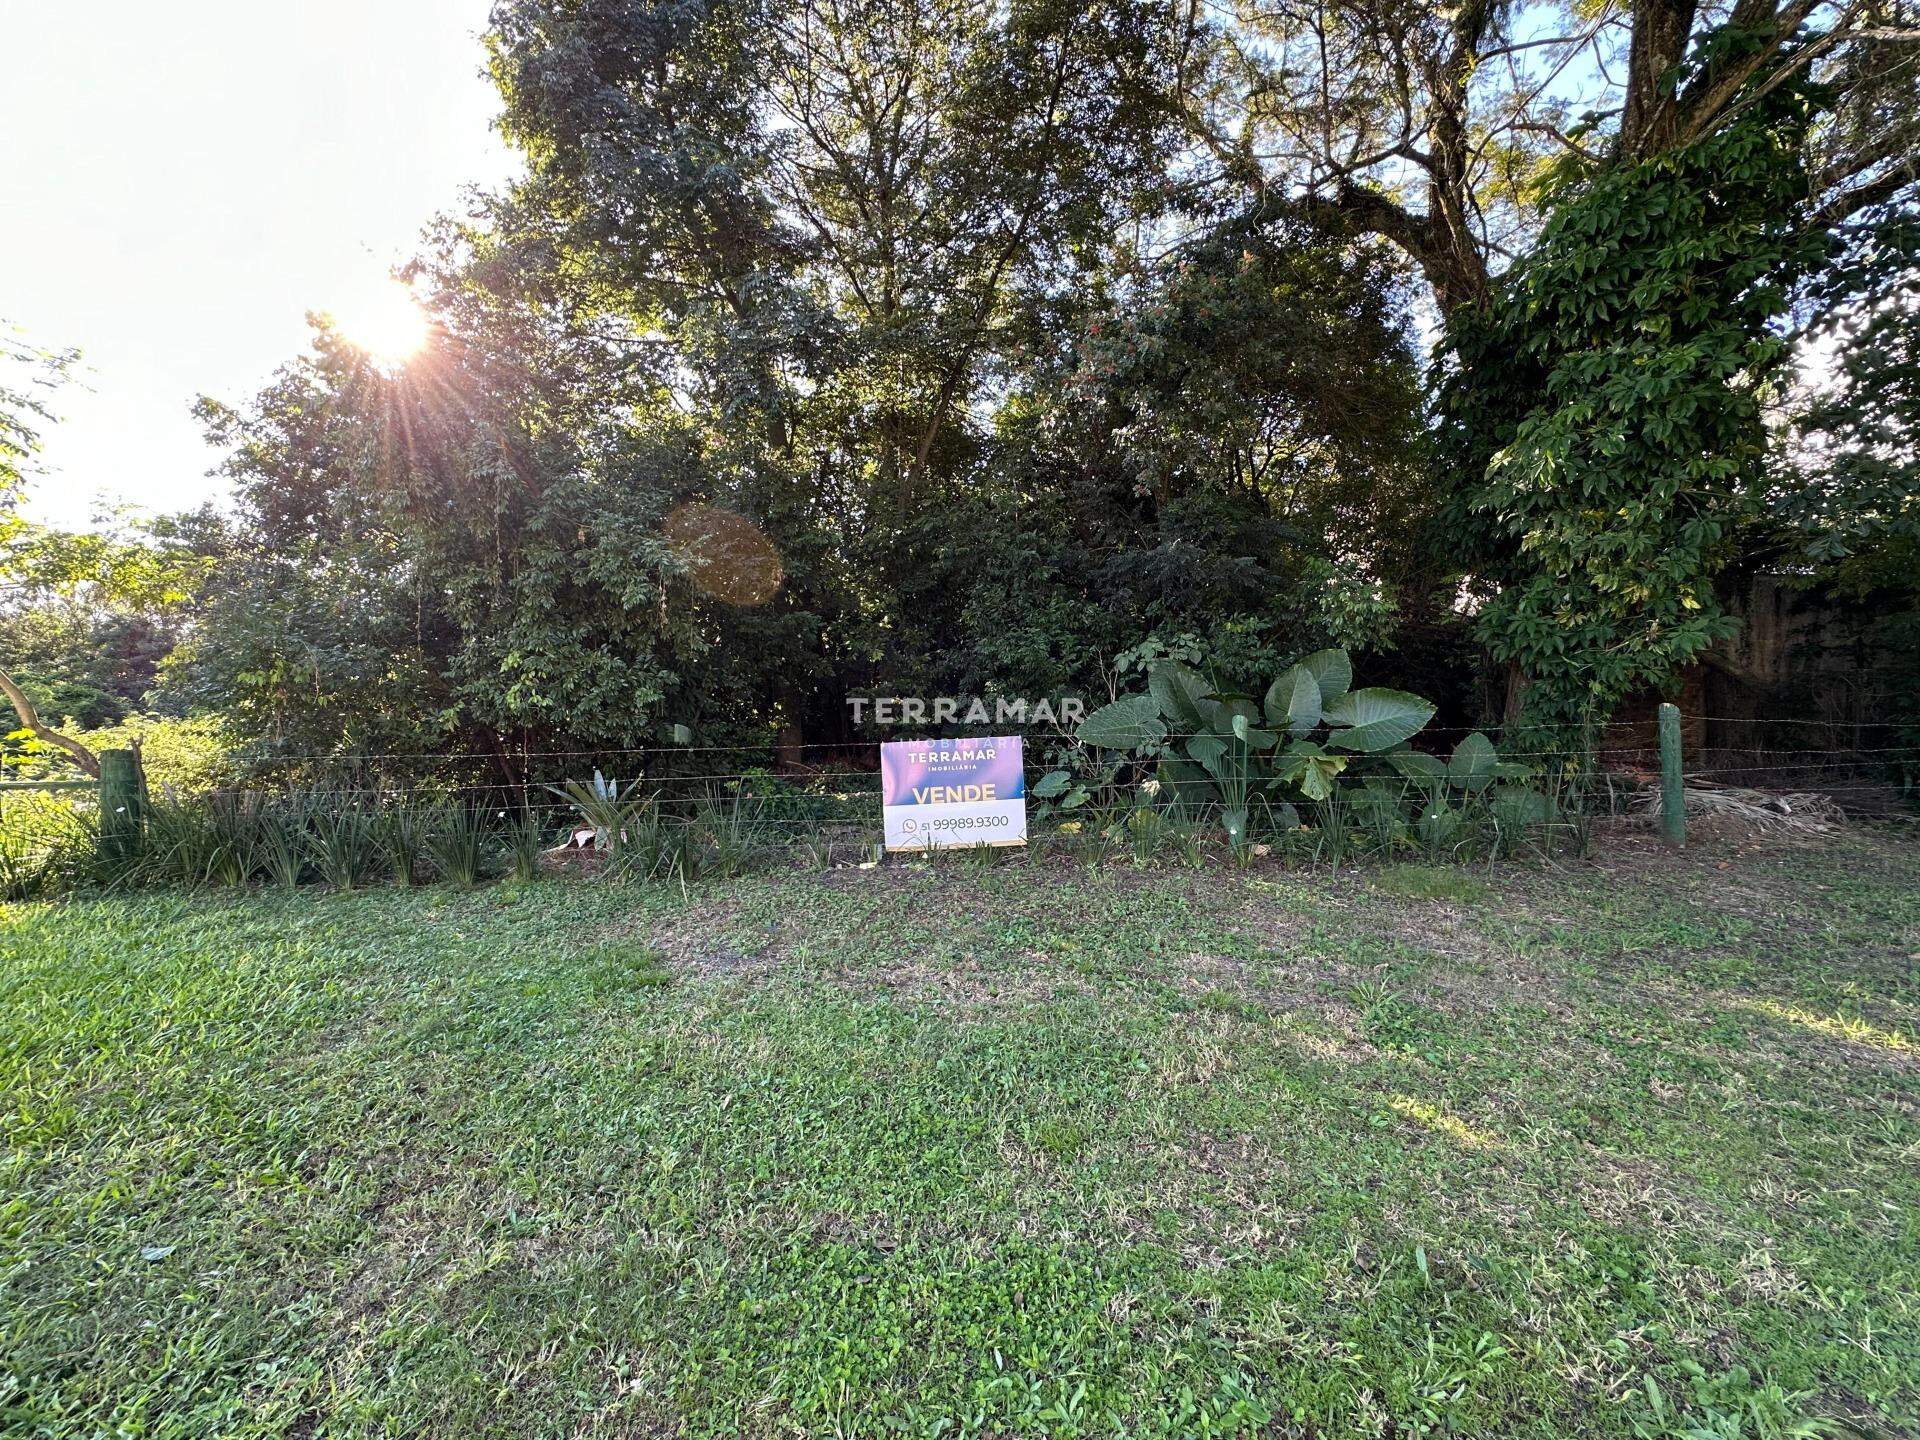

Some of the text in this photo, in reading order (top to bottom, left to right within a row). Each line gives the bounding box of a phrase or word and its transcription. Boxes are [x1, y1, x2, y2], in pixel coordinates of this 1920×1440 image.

[908, 749, 996, 764] TERRAMAR
[912, 783, 996, 805] VENDE
[921, 815, 1009, 831] 51 99989.9300
